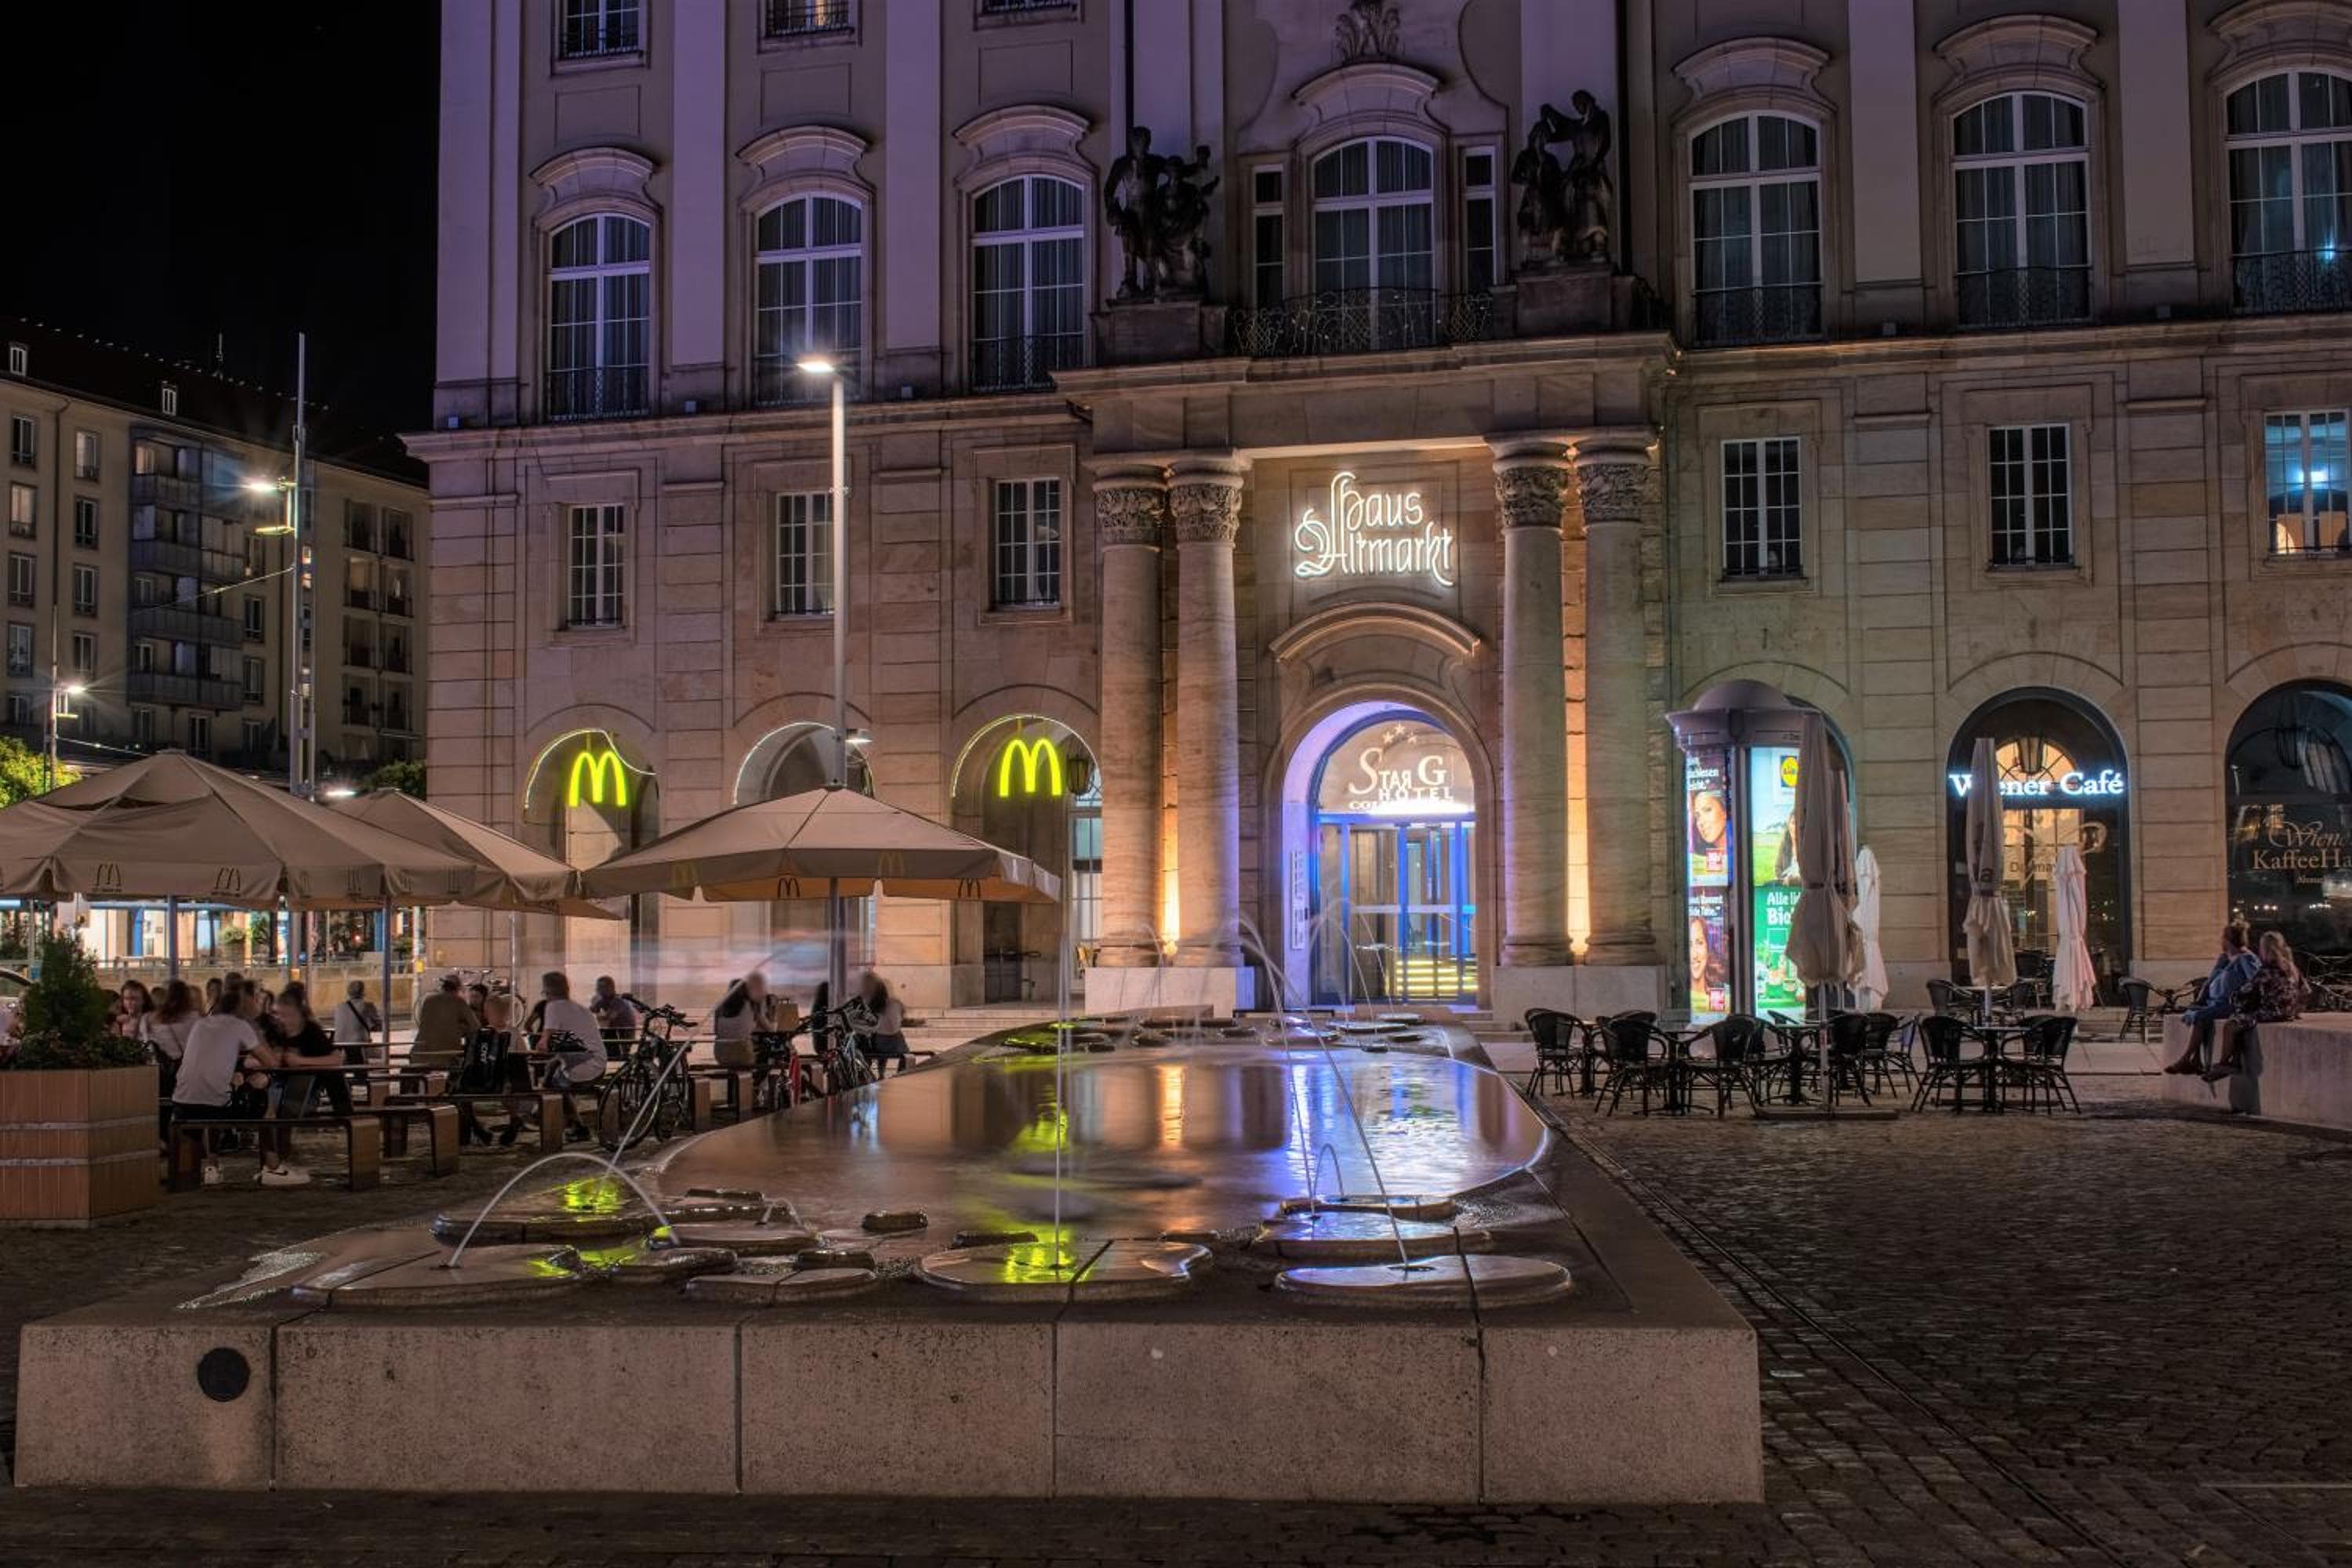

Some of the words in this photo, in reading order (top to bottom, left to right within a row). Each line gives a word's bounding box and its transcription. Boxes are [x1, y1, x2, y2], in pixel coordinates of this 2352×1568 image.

[1417, 754, 1447, 786] G
[2060, 769, 2125, 795] Café
[1378, 786, 1454, 800] HOTEL
[1766, 891, 1789, 906] Alle
